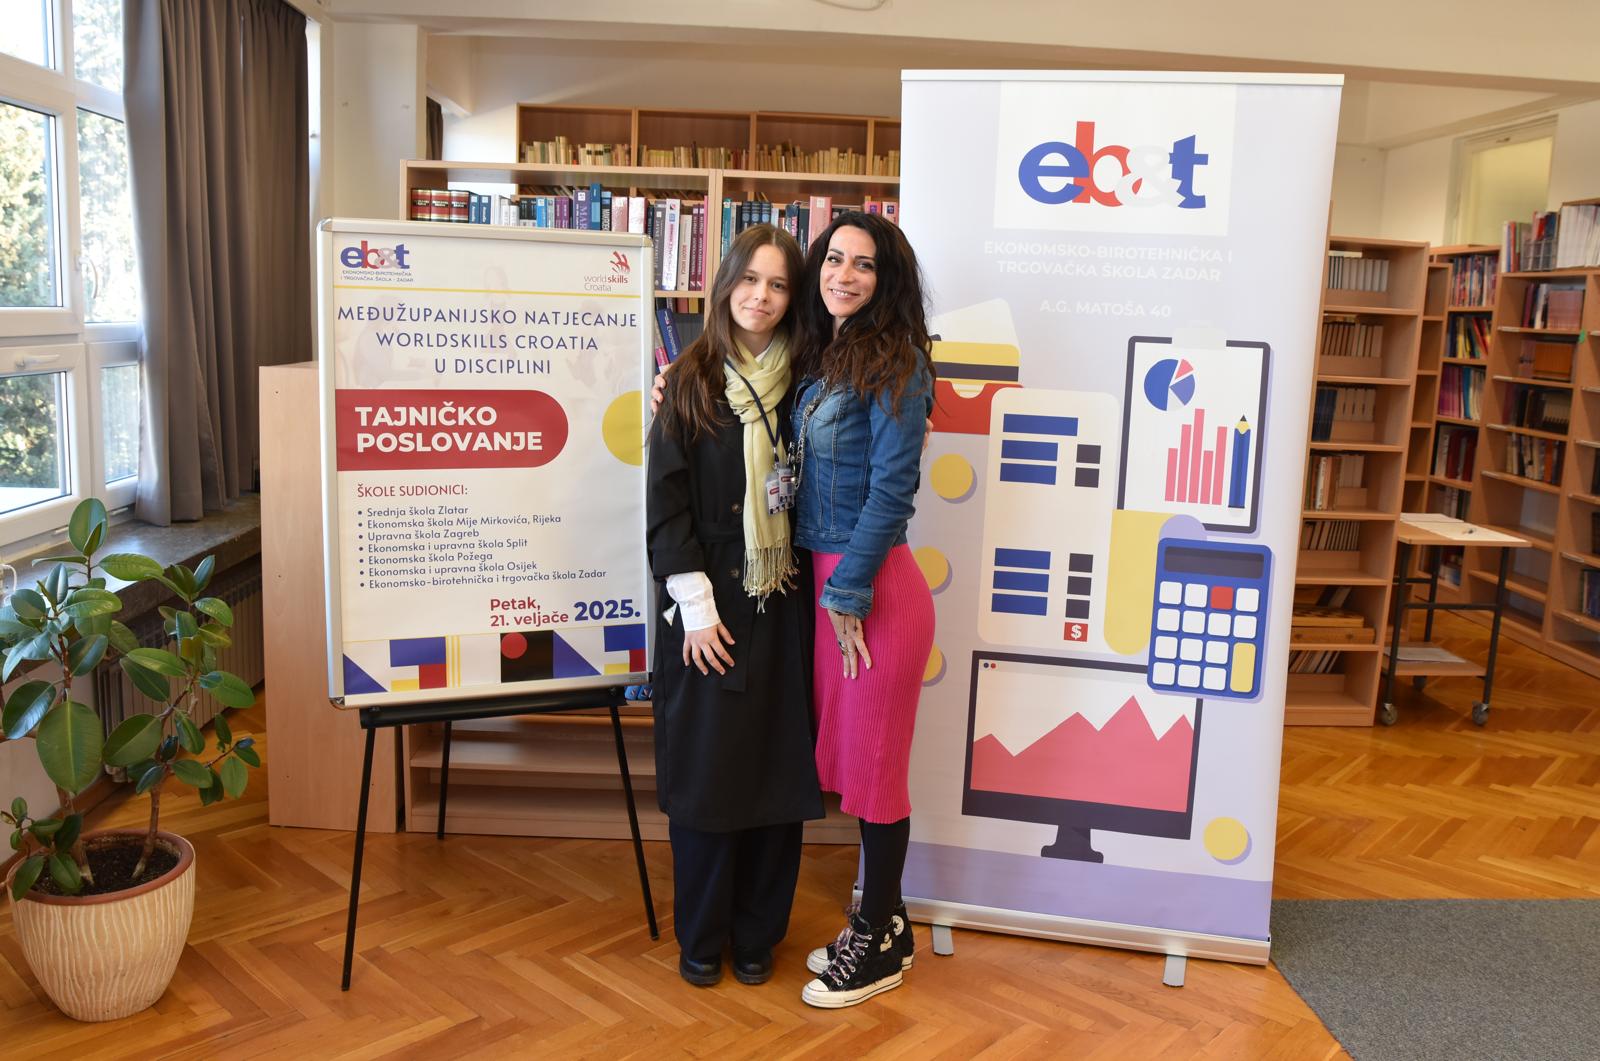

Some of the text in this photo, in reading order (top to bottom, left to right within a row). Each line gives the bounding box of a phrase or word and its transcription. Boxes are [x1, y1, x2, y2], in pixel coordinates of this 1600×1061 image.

[996, 259, 1222, 281] TRGOVAČKA ŠKOLA ZADAR
[584, 282, 612, 292] Croatia
[338, 304, 637, 327] MEĐUŽUPANIJSKO NATJECANJE
[1040, 300, 1172, 318] A.G. MATOŠA 40
[376, 331, 598, 350] WORLDSKILLS CROATIA
[435, 358, 551, 374] U DISCIPLINI
[355, 401, 497, 427] TAJNIČKO
[357, 431, 543, 453] POSLOVANJE
[358, 484, 468, 497] ŠKOLE SUDIONICI:
[367, 506, 468, 518] Srednja škola Zlatar
[367, 515, 561, 529] Ekonomska škola Mije Mirkovića, Rijeka
[368, 529, 479, 543] Upravna škola Zagreb
[368, 543, 425, 553] Ekonomska
[434, 542, 475, 551] upravna
[478, 539, 504, 548] škola
[507, 539, 527, 549] Split
[369, 552, 493, 565] Ekonomska škola Požega
[369, 566, 426, 576] Ekonomska
[435, 565, 476, 576] upravna
[479, 562, 504, 572] škola
[507, 561, 537, 572] Osijek
[369, 576, 494, 589] Ekonomsko-birotehnička
[502, 572, 550, 584] trgovačka
[552, 571, 576, 580] škola
[579, 570, 606, 579] Zadar
[491, 597, 541, 611] Petak,
[491, 599, 640, 627] 21. veljače 2025.
